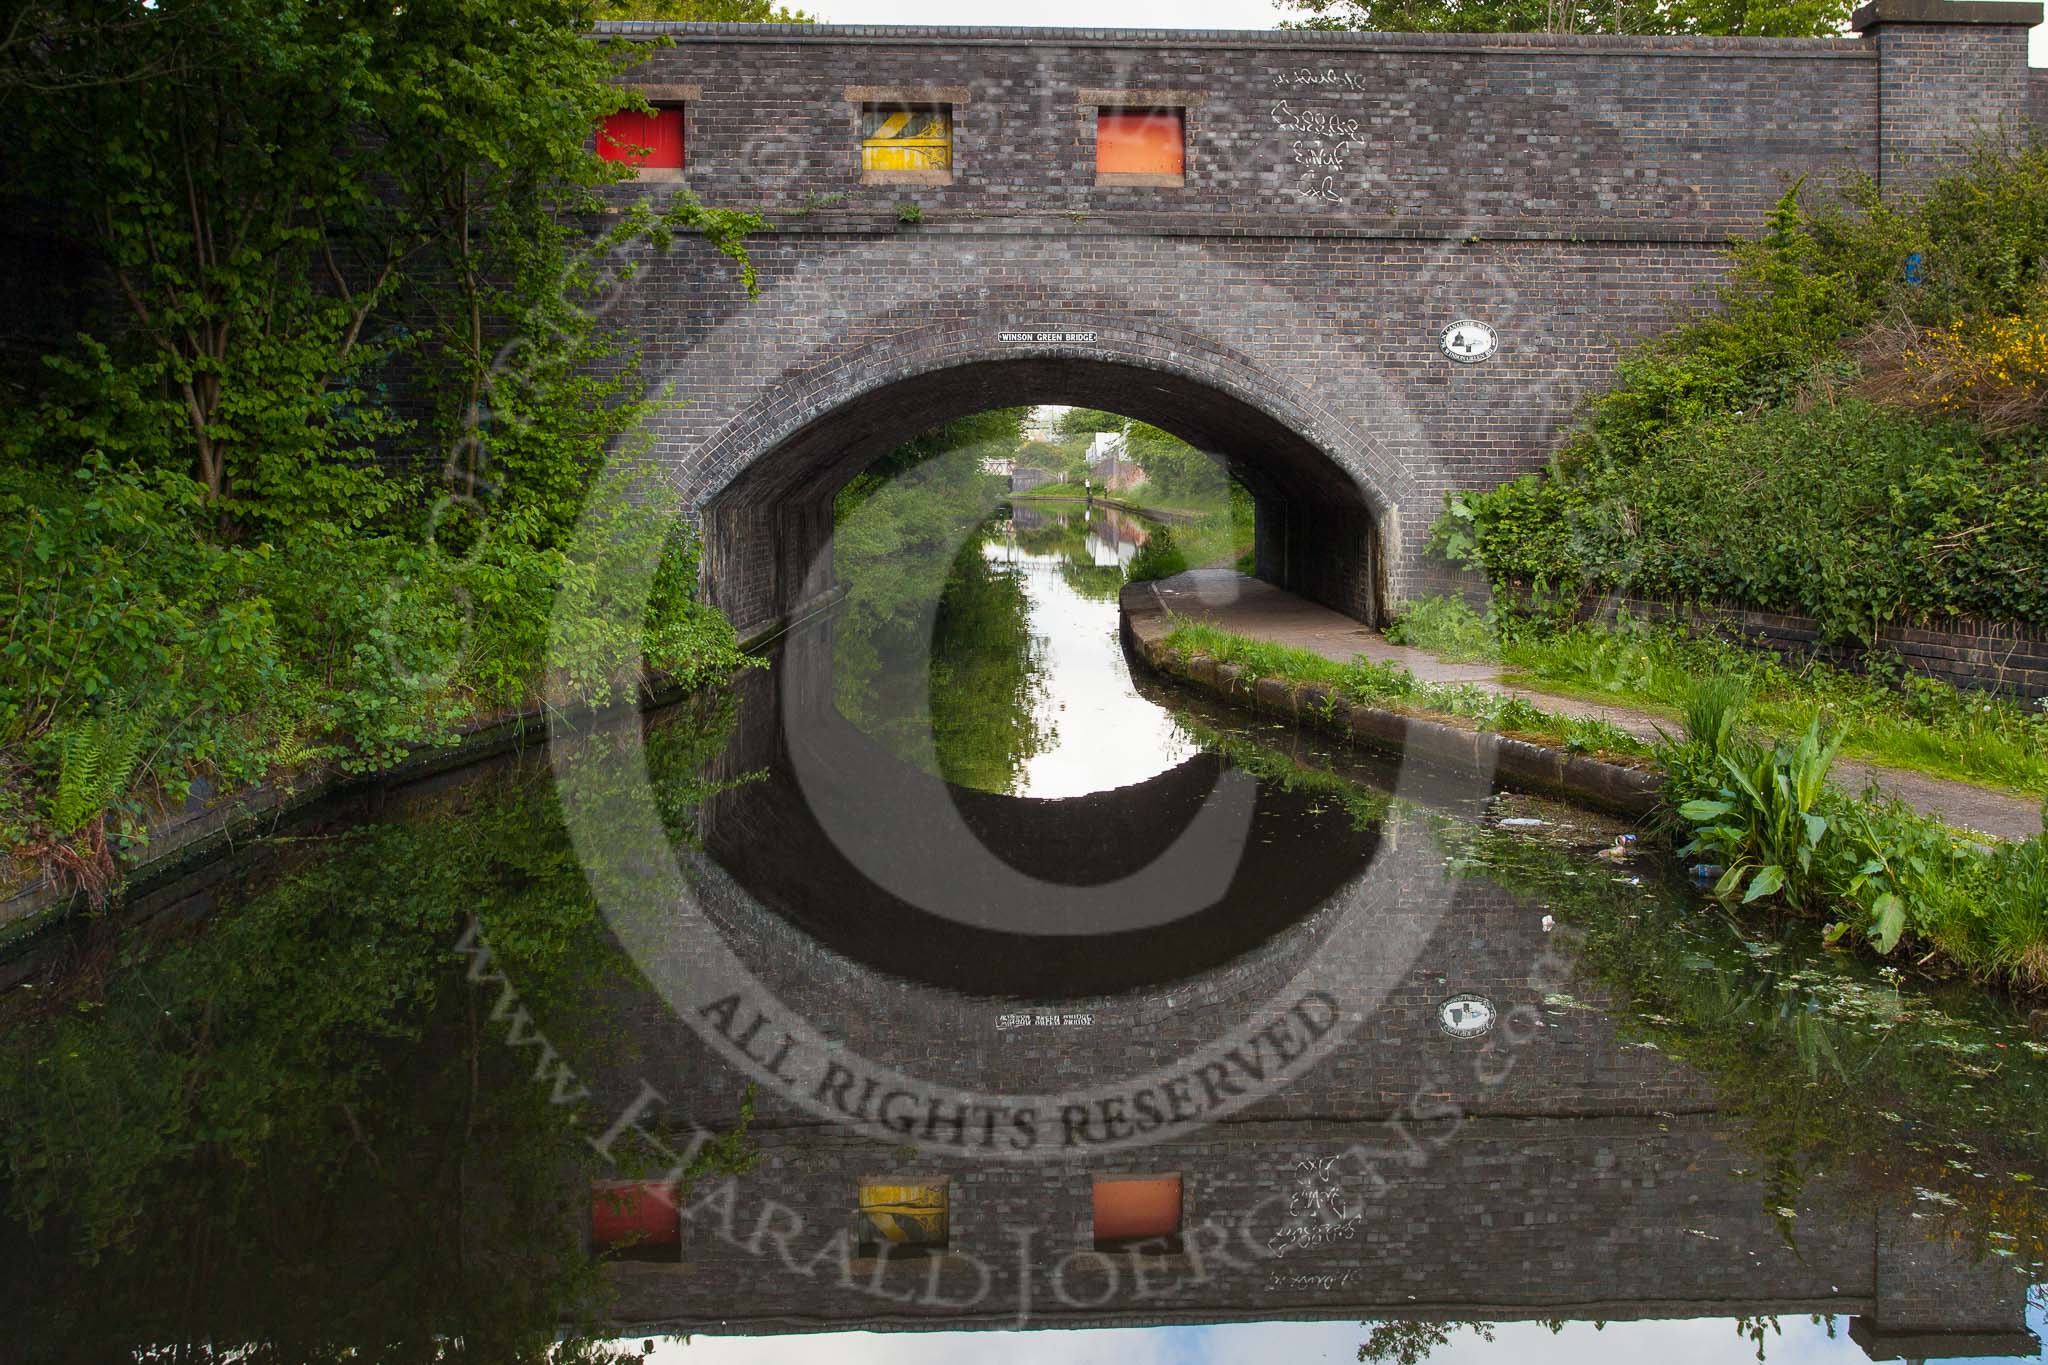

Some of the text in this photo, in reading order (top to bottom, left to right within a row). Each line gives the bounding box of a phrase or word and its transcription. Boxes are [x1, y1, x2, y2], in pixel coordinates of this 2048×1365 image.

[1001, 333, 1094, 342] WINSON GREEN BRIDGE
